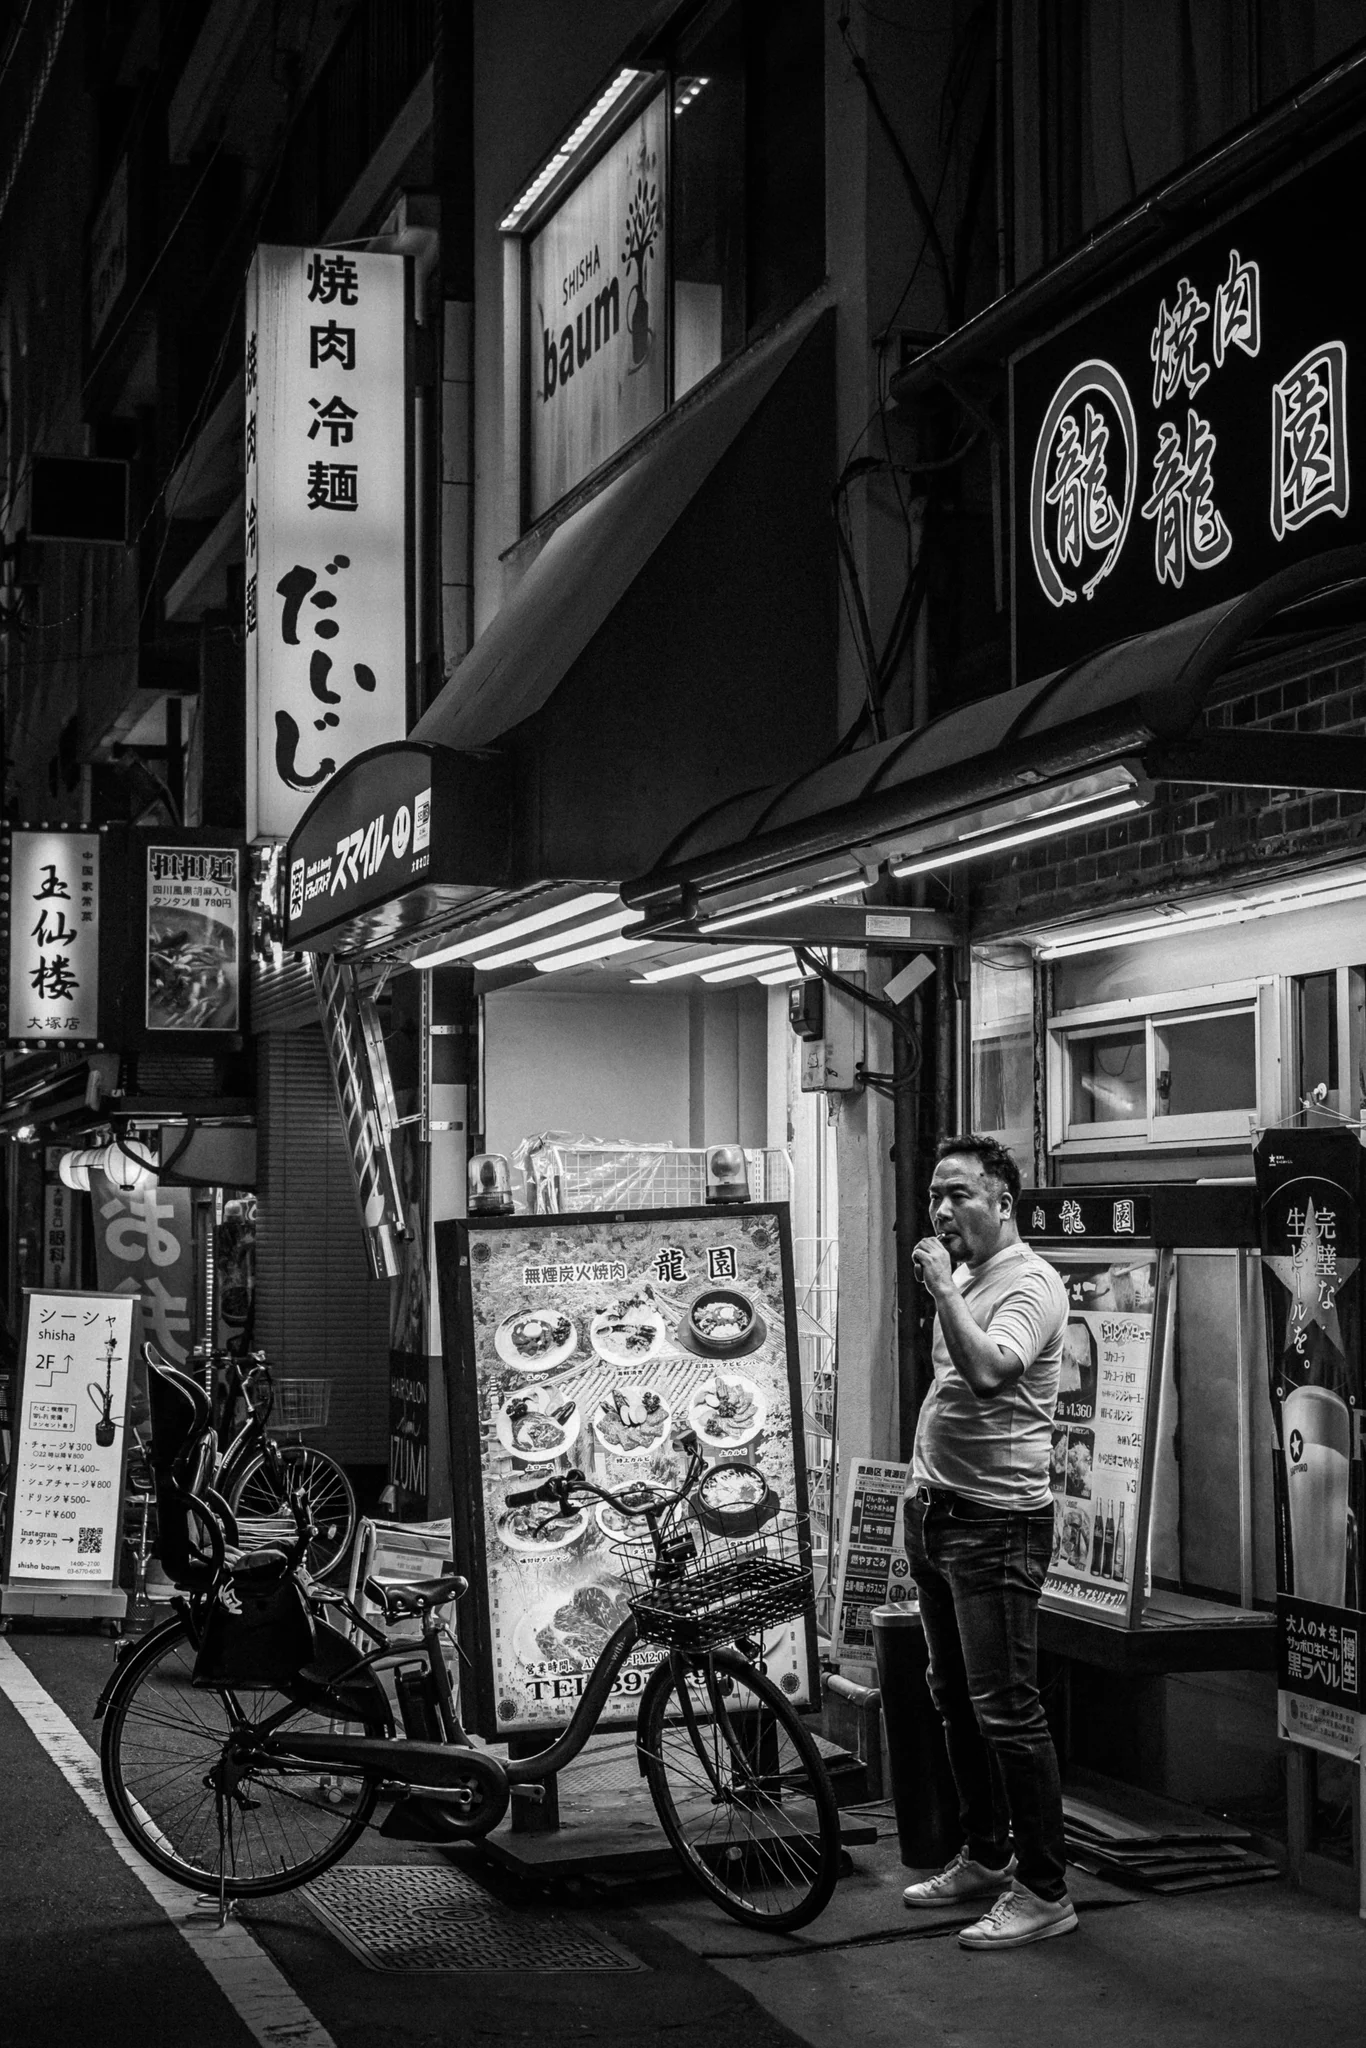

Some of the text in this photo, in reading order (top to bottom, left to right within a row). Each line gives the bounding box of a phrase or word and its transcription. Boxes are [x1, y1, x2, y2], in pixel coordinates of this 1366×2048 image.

[562, 244, 601, 306] SHISHA
[543, 276, 620, 404] baum
[1150, 248, 1261, 409] 焼肉
[1141, 340, 1350, 589] 龍園
[275, 553, 377, 794] だいじ
[330, 814, 390, 898] スマイル
[204, 898, 232, 908] 780円
[28, 864, 80, 1001] 玉仙楼
[26, 1016, 81, 1031] 大塚店
[1058, 1199, 1135, 1235] 龍園
[524, 1245, 738, 1285] 無煙炭火焼肉 龍園
[1314, 1206, 1338, 1310] 完璧な
[39, 1308, 117, 1328] シーシャ
[38, 1329, 76, 1342] shisha
[35, 1354, 55, 1370] 2F
[526, 1372, 549, 1381] ユッケ
[1066, 1402, 1092, 1418] ¥1,360
[390, 1434, 427, 1497] IZUMI
[525, 1463, 555, 1472] 上ロース
[20, 1528, 58, 1539] Instagram
[20, 1537, 57, 1547] アカウント
[17, 1561, 61, 1571] shisha baum
[895, 1560, 906, 1572] 火
[1286, 1635, 1341, 1662] サッポロ生ビール
[1343, 1636, 1356, 1685] 樽生
[1287, 1650, 1341, 1688] 黒ラベル
